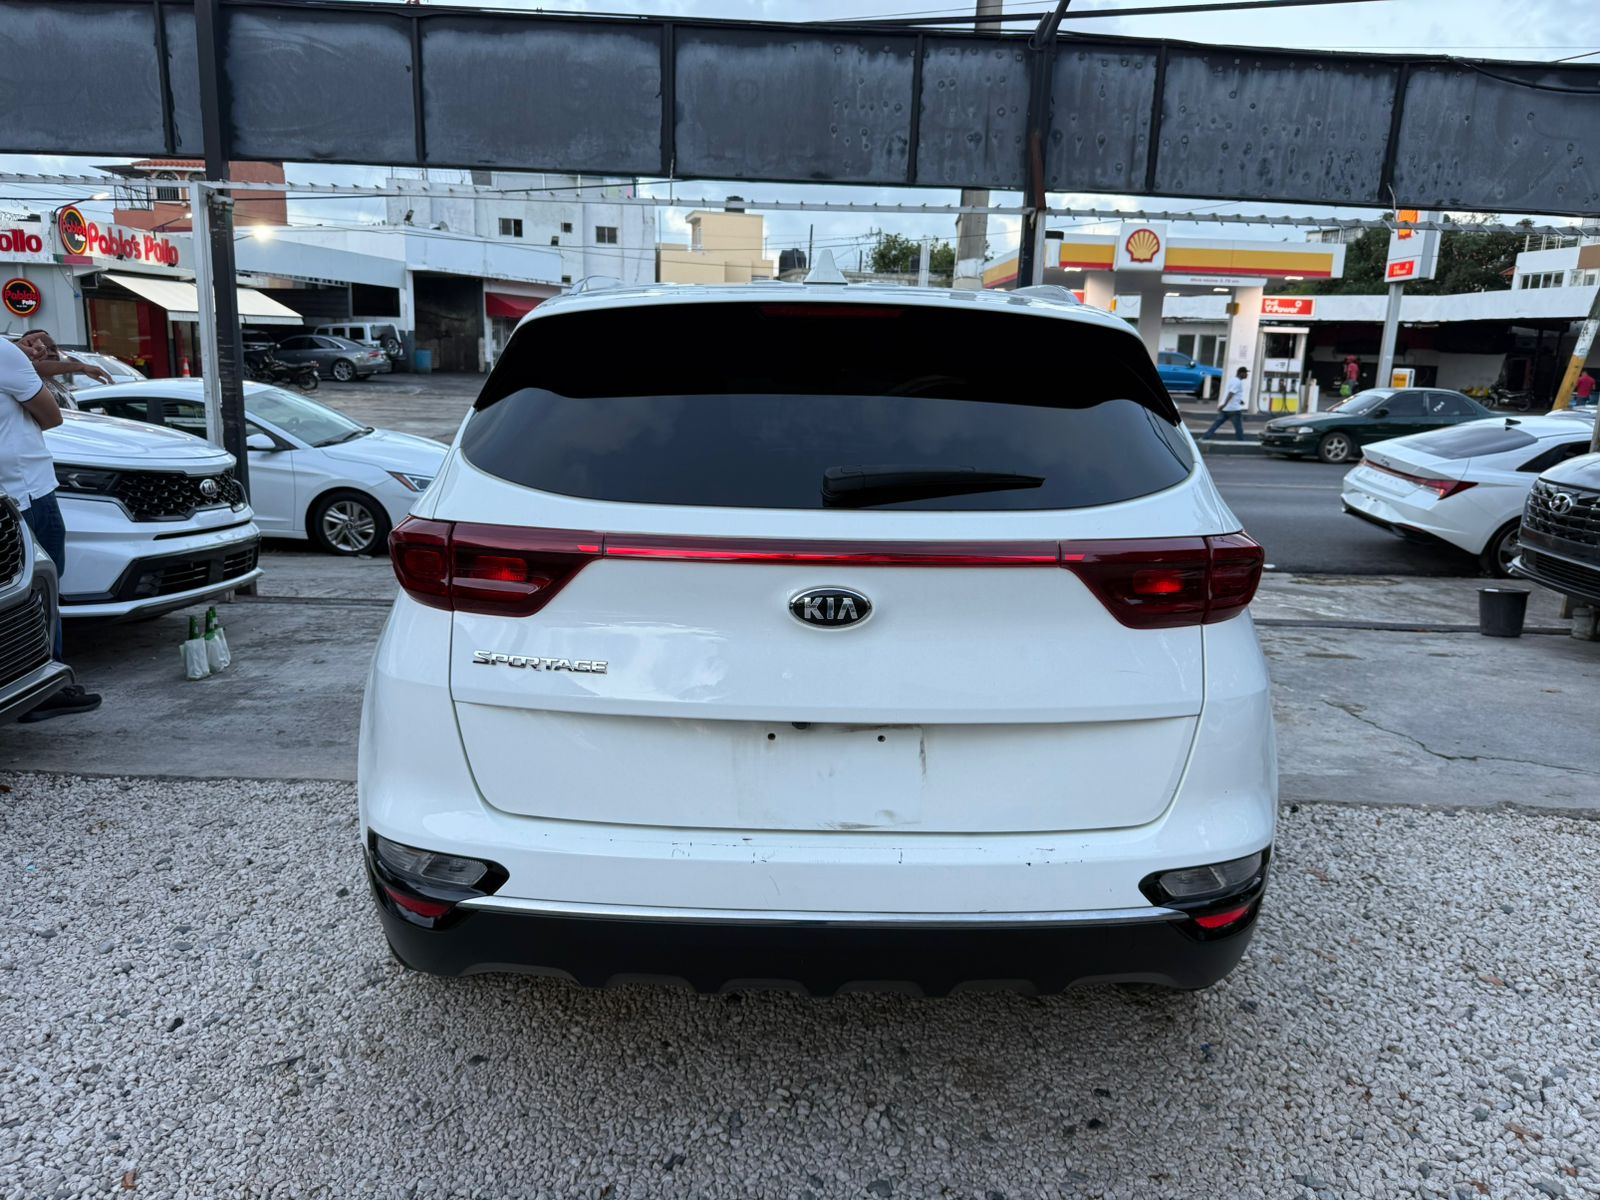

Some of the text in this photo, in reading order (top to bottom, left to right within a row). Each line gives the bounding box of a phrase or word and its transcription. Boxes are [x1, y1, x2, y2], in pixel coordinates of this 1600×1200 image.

[88, 222, 179, 265] Pablo's Pollo
[804, 597, 858, 620] KIA
[472, 650, 608, 674] SPORTAGE
